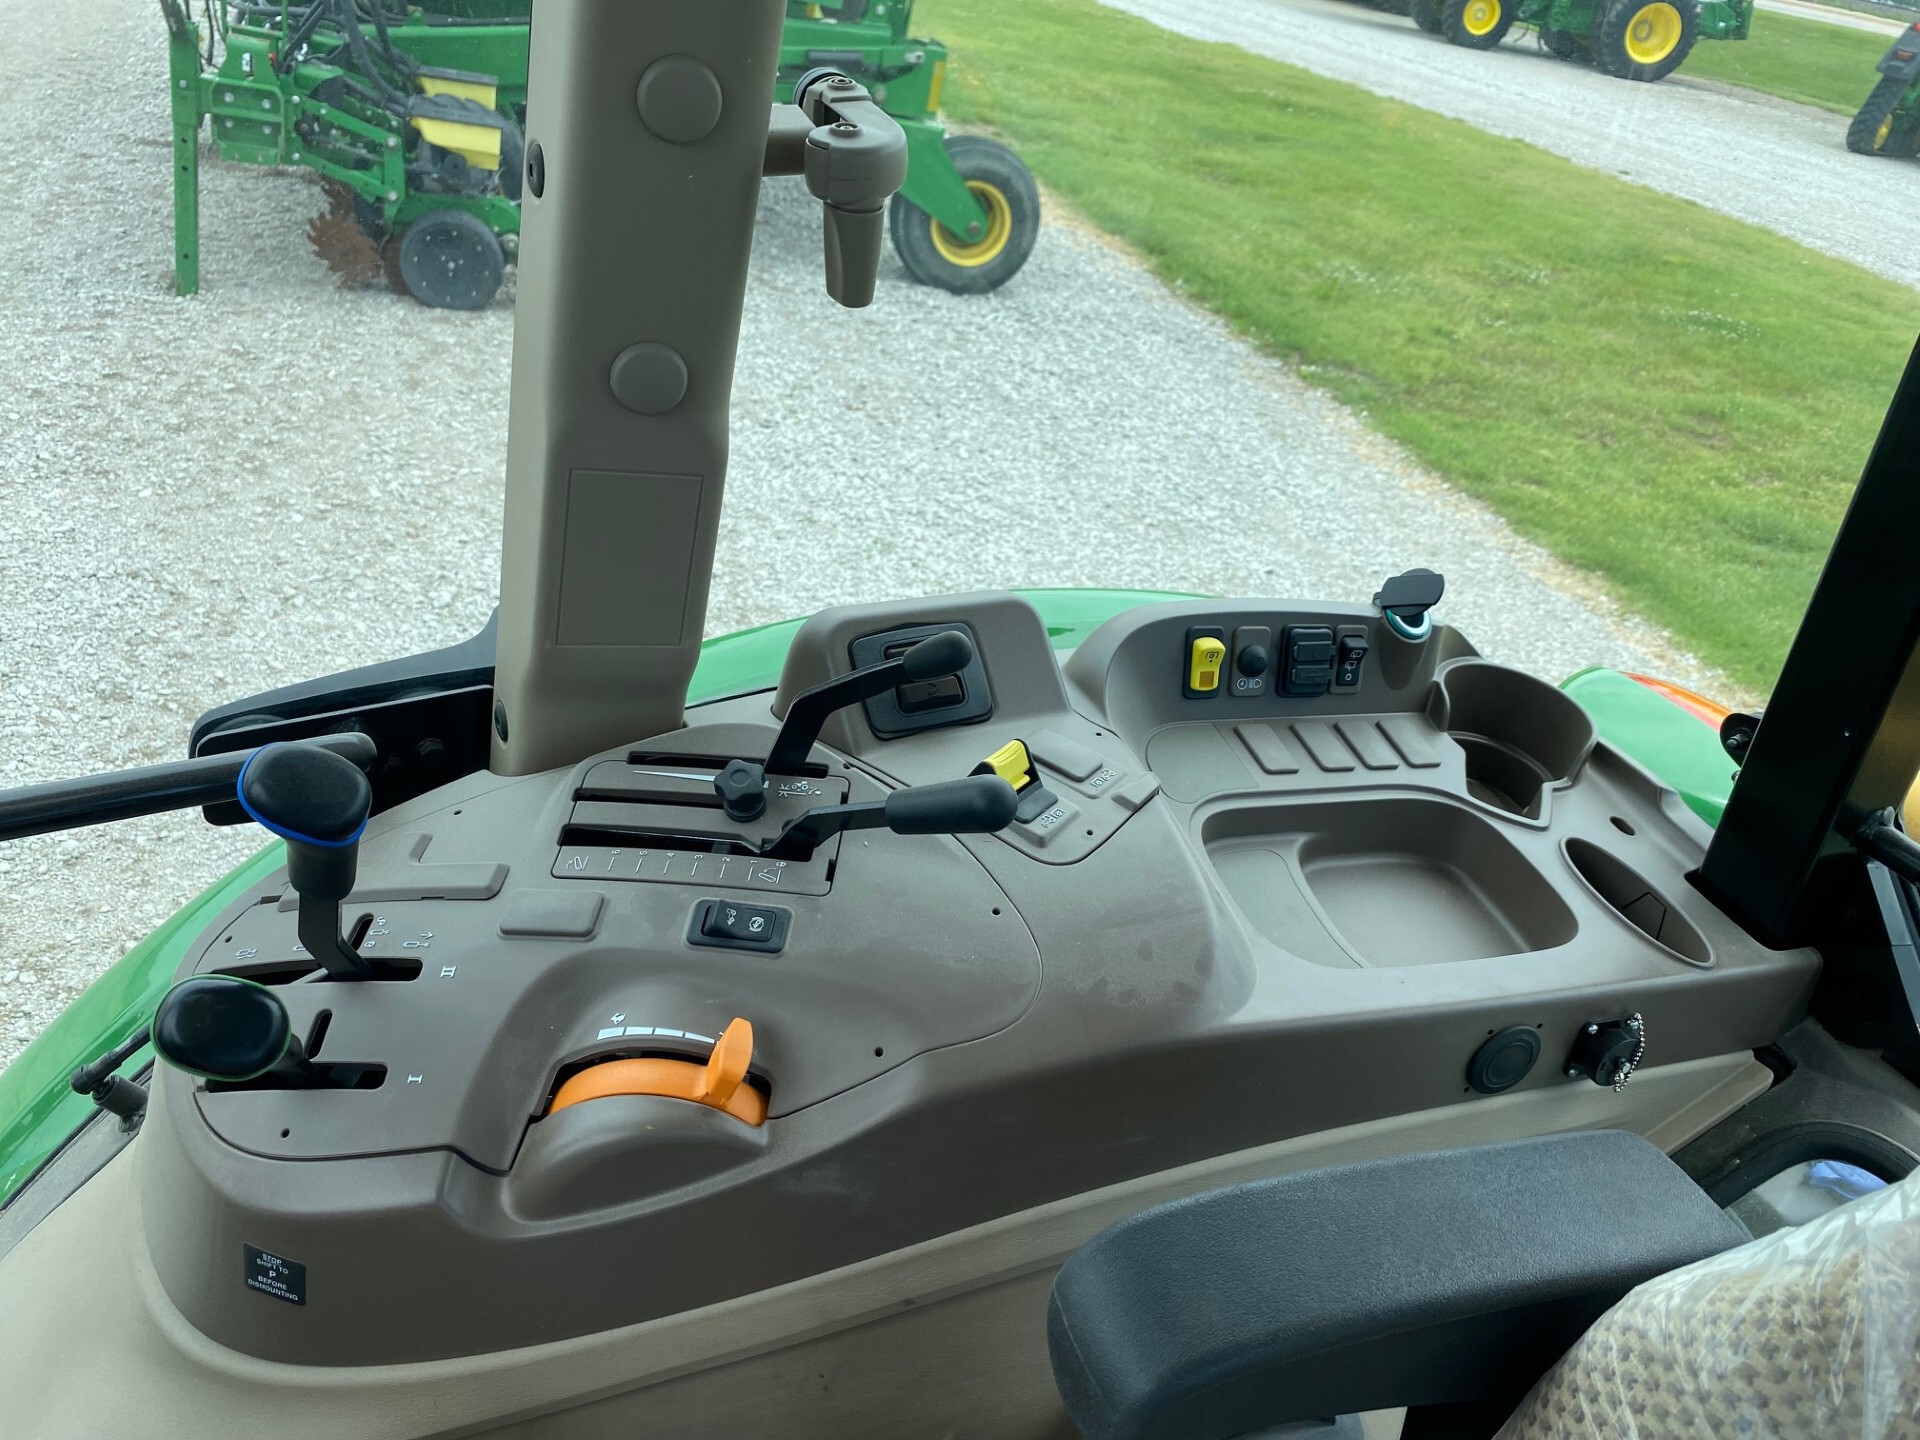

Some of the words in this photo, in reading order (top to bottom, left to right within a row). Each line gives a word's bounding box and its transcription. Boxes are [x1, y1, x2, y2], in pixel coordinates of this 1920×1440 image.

[262, 1253, 282, 1265] STOP
[269, 1270, 276, 1278] P
[278, 1266, 289, 1274] TO
[258, 1275, 288, 1291] BEFORE
[247, 1278, 298, 1301] DISMOUNTING
